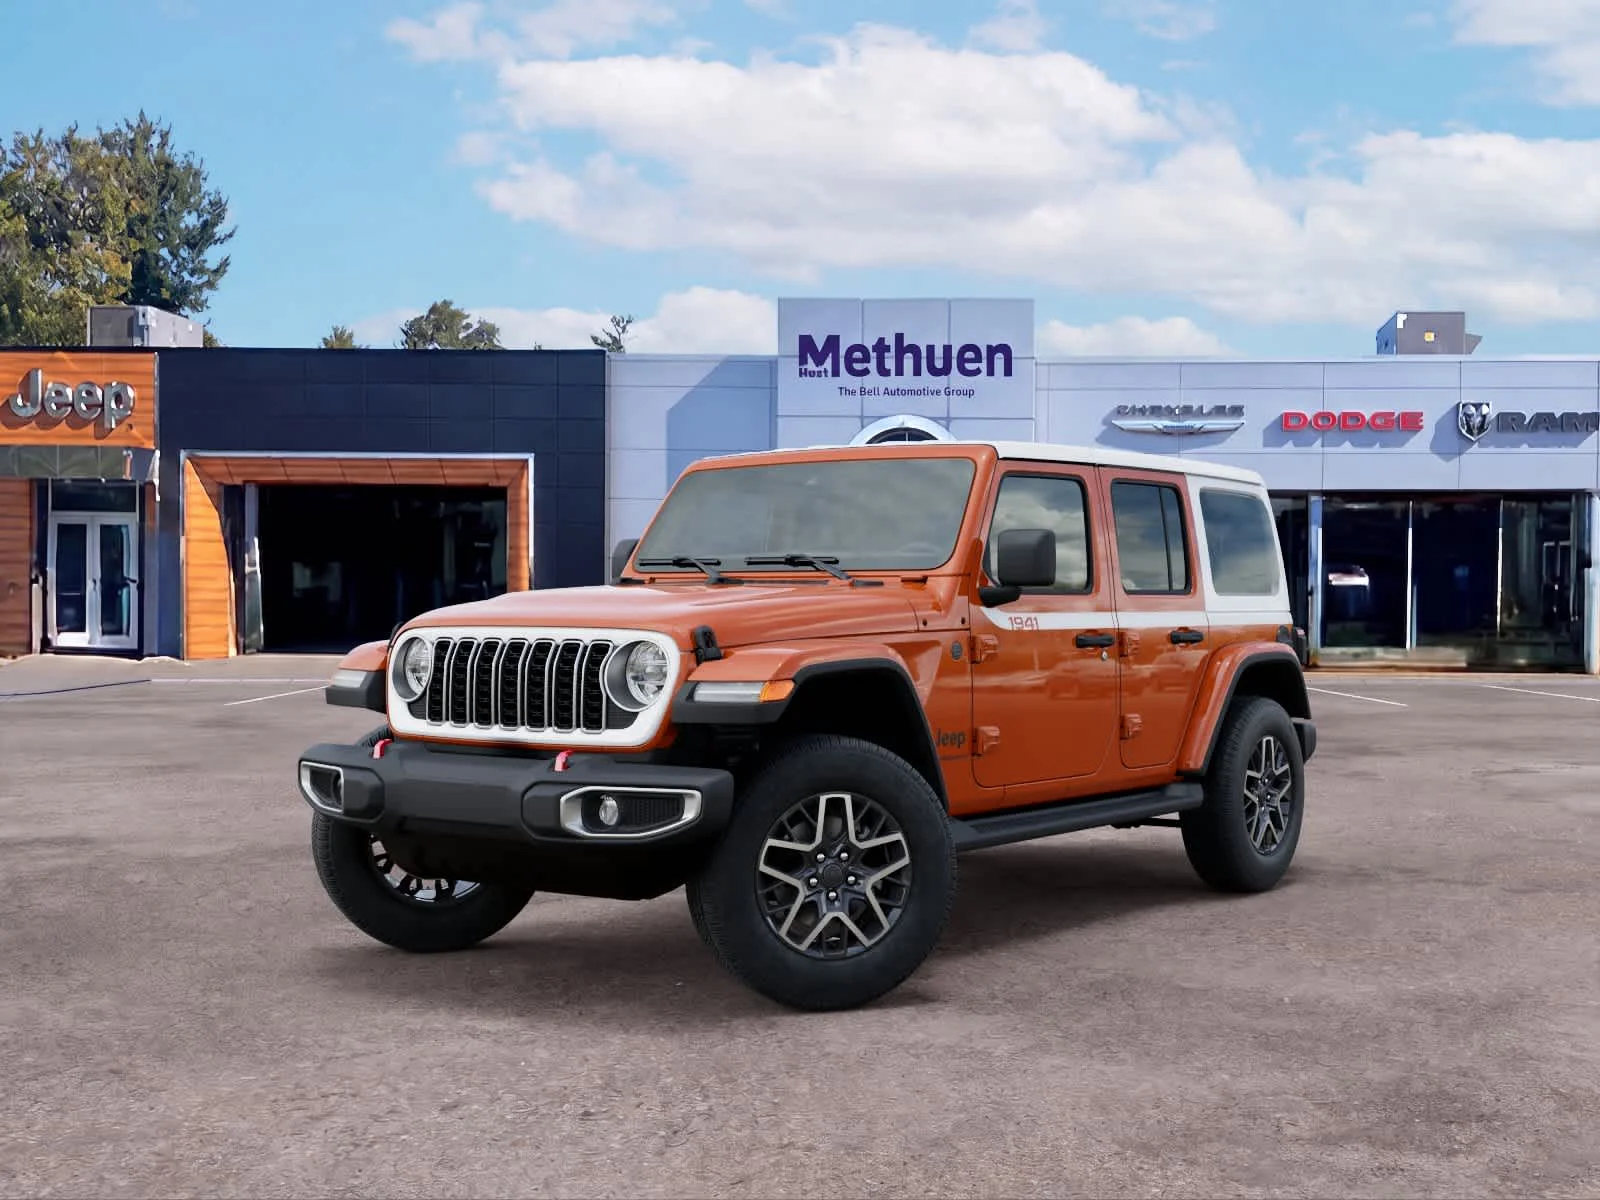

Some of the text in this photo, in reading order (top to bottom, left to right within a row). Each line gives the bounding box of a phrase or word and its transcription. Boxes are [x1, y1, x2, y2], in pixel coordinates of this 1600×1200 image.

[799, 333, 1013, 377] Methuen
[10, 368, 136, 429] Jeep
[838, 386, 975, 399] The Bell Automotive Group
[1282, 410, 1424, 431] DODGE
[1497, 411, 1599, 432] RAM
[1008, 616, 1040, 632] 1941
